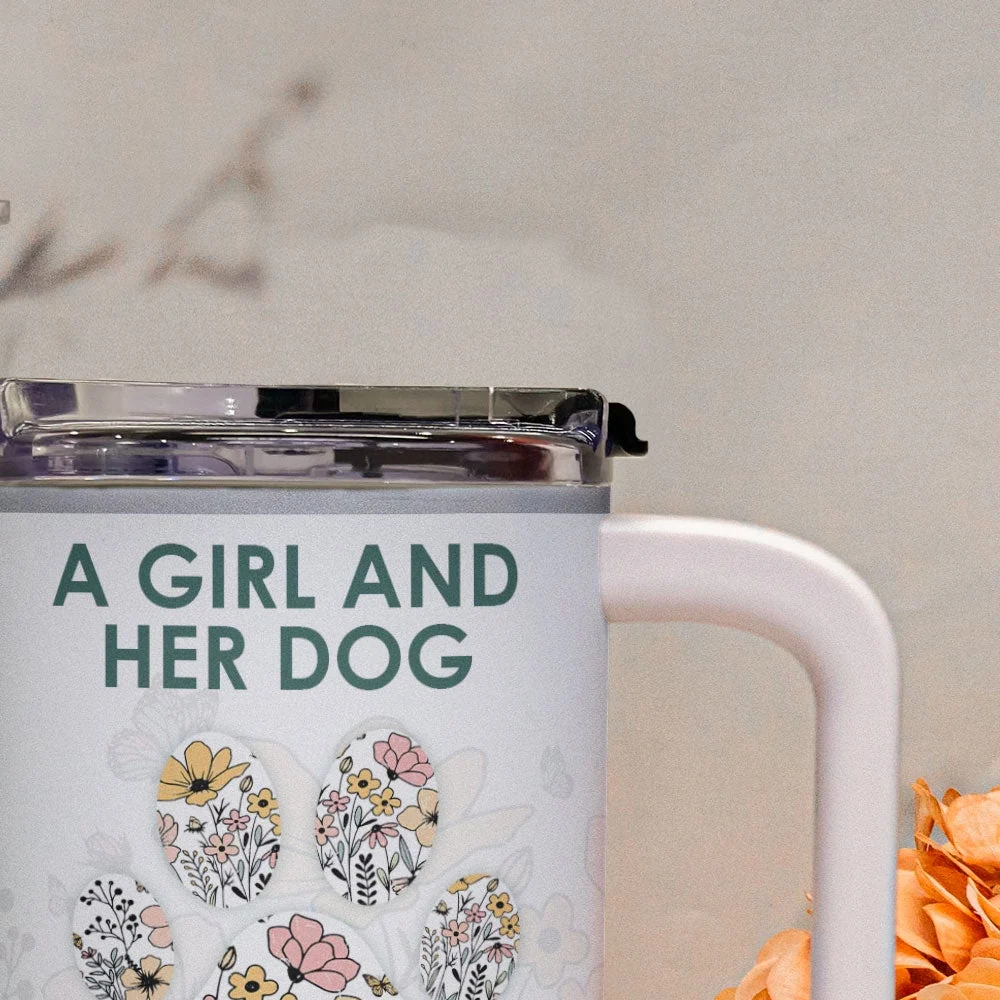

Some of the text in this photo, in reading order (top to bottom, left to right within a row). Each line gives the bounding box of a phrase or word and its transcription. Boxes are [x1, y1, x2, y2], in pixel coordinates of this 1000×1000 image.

[53, 543, 518, 609] A GIRL AND
[104, 623, 472, 691] HER DOG
